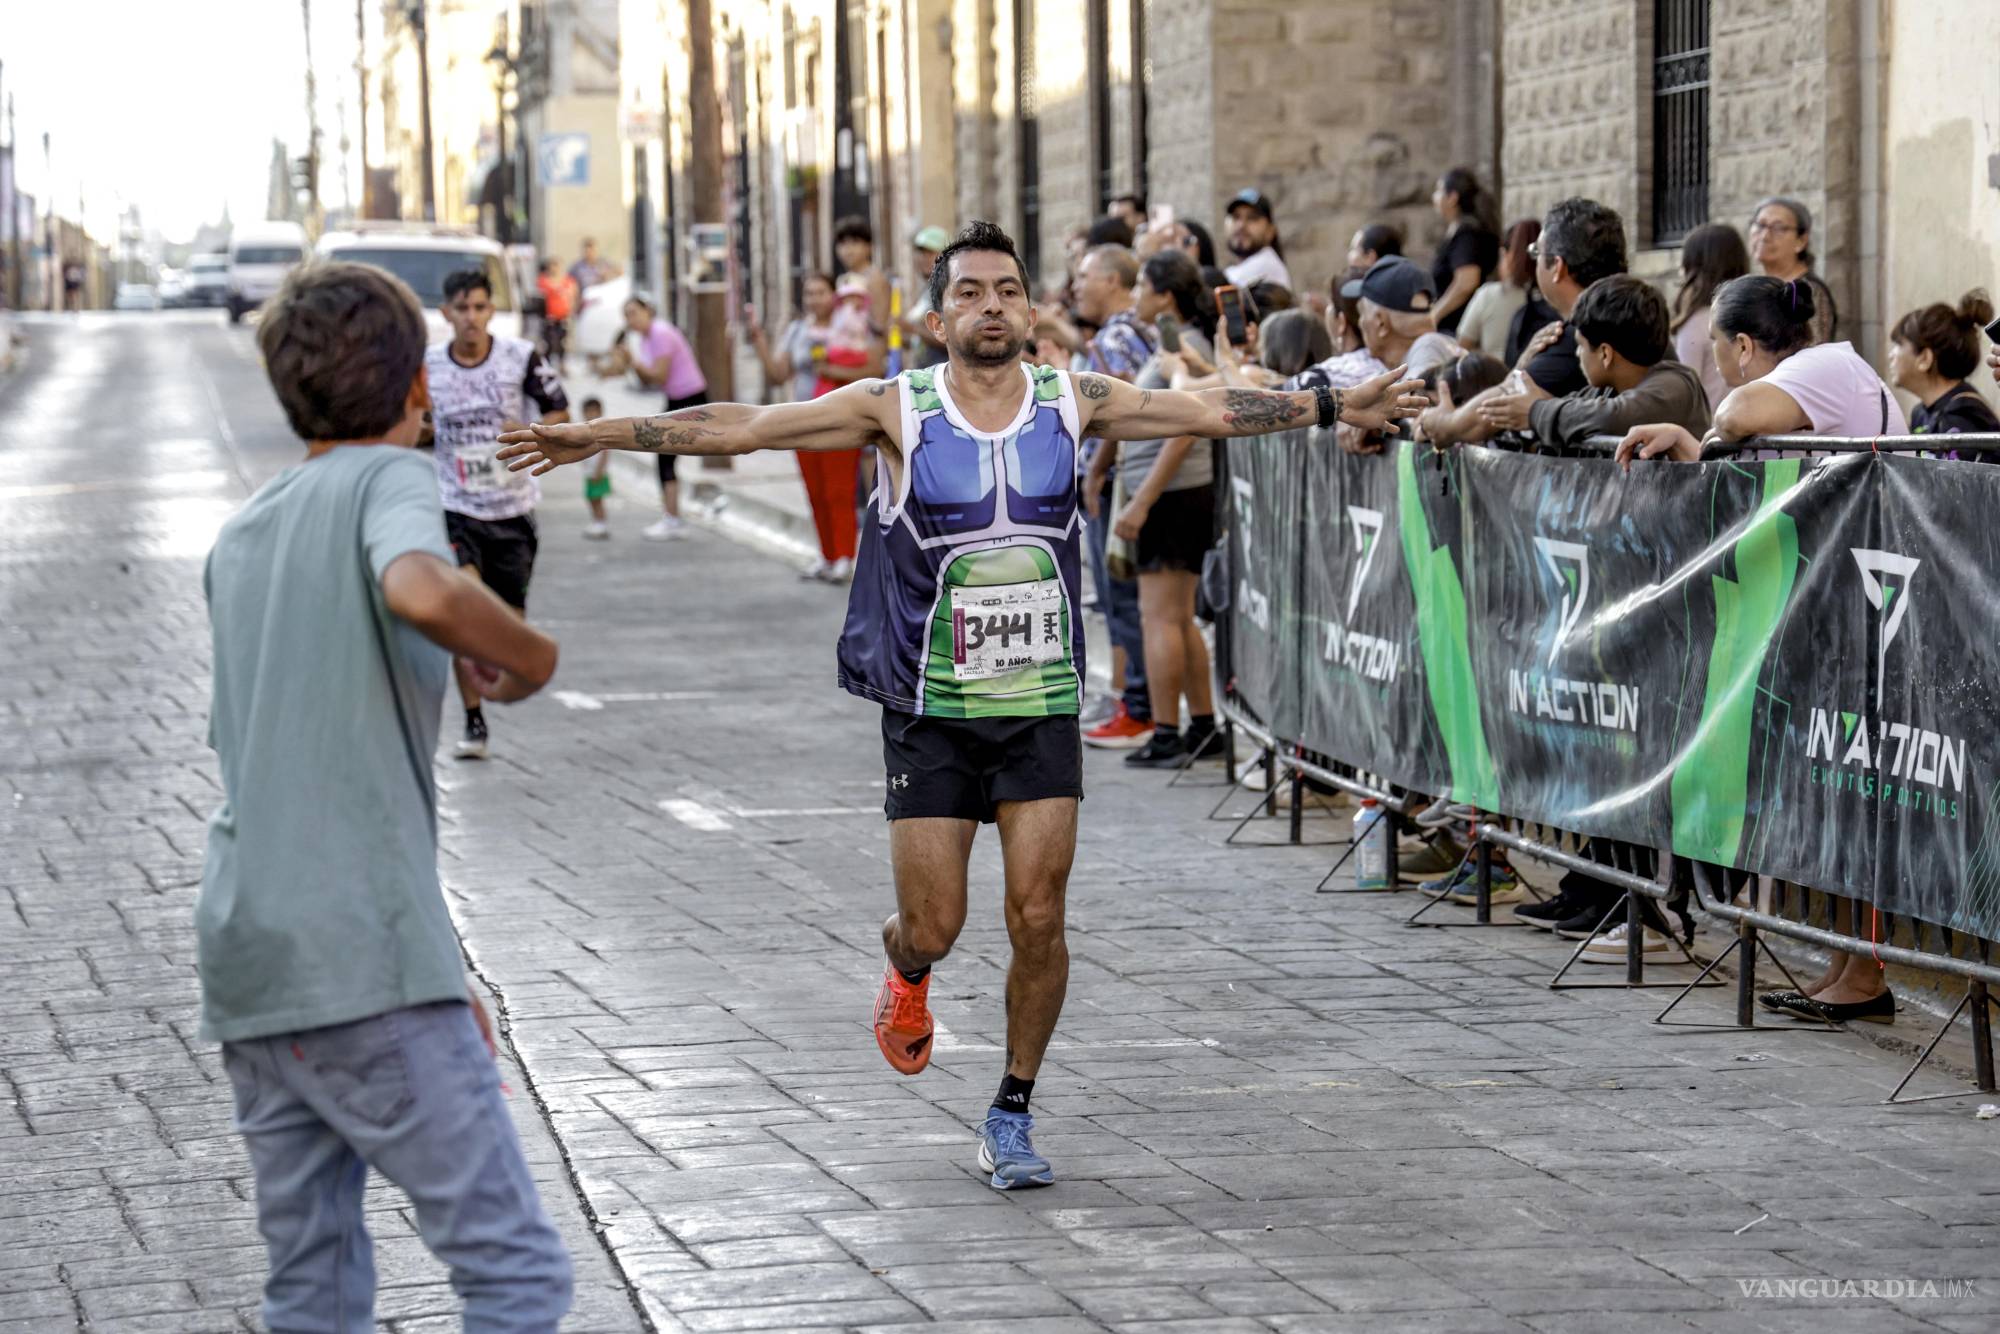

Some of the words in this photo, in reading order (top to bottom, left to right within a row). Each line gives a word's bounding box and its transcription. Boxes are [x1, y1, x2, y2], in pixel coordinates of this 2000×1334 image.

[965, 612, 1032, 650] 344
[1043, 611, 1059, 644] 344
[995, 658, 1005, 668] 10
[1008, 656, 1033, 667] AÑOS
[1509, 668, 1528, 715] IN
[1536, 675, 1640, 733] ACTION
[1806, 707, 1838, 762] IN
[1811, 765, 1874, 796] EVENTOS
